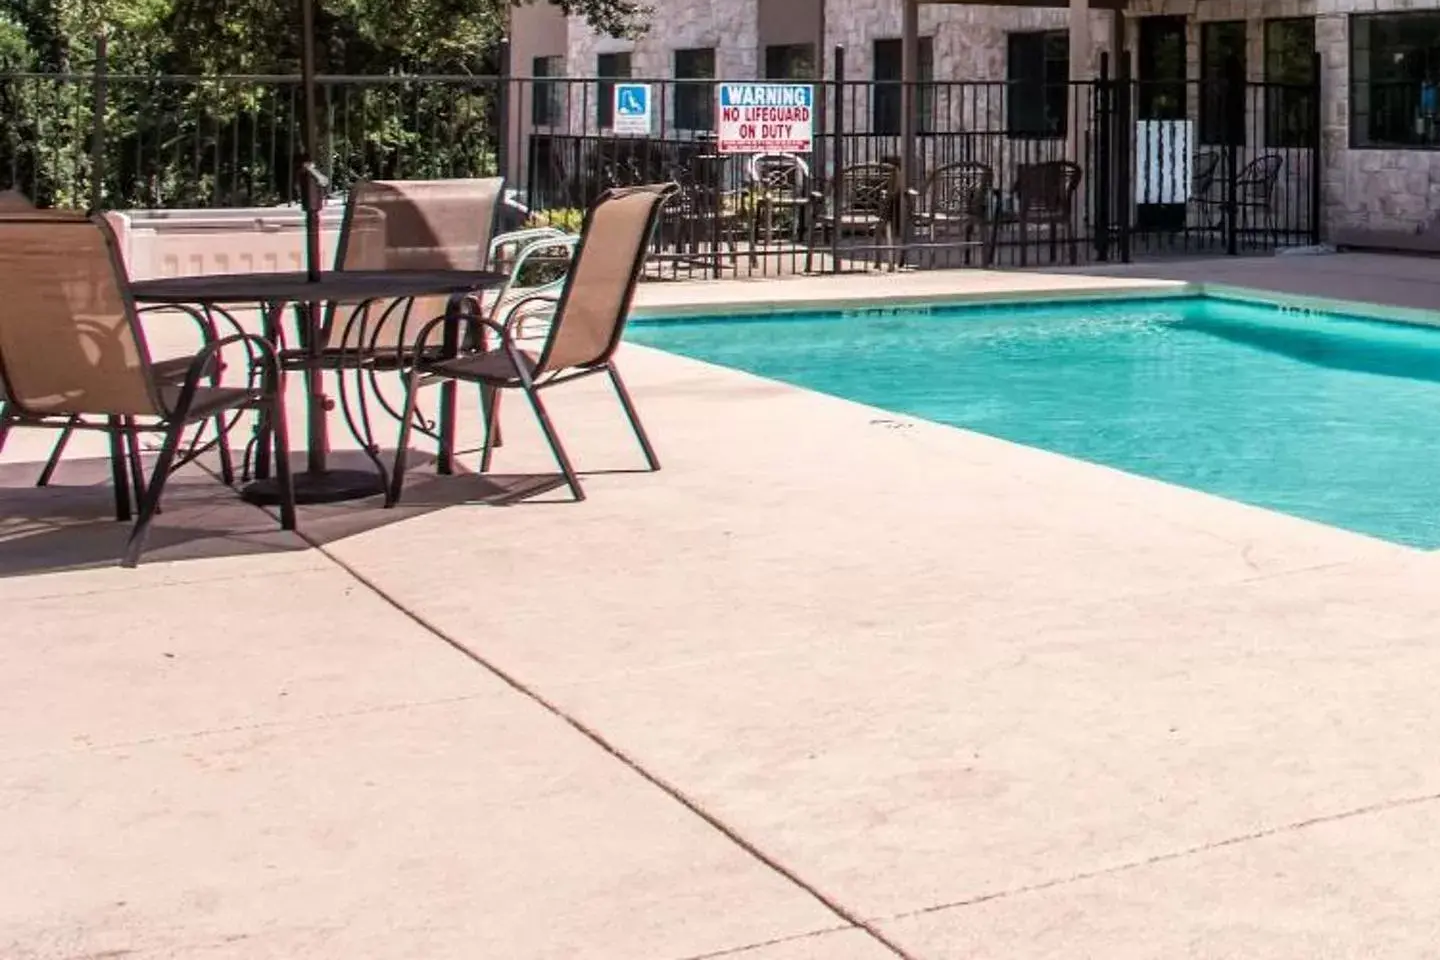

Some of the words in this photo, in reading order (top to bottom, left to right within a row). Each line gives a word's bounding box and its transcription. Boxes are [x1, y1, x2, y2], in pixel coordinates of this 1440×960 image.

[728, 86, 806, 105] WARNING
[723, 107, 740, 122] NO
[745, 107, 809, 122] LIFEGUARD
[739, 124, 756, 139] ON
[762, 124, 792, 139] DUTY
